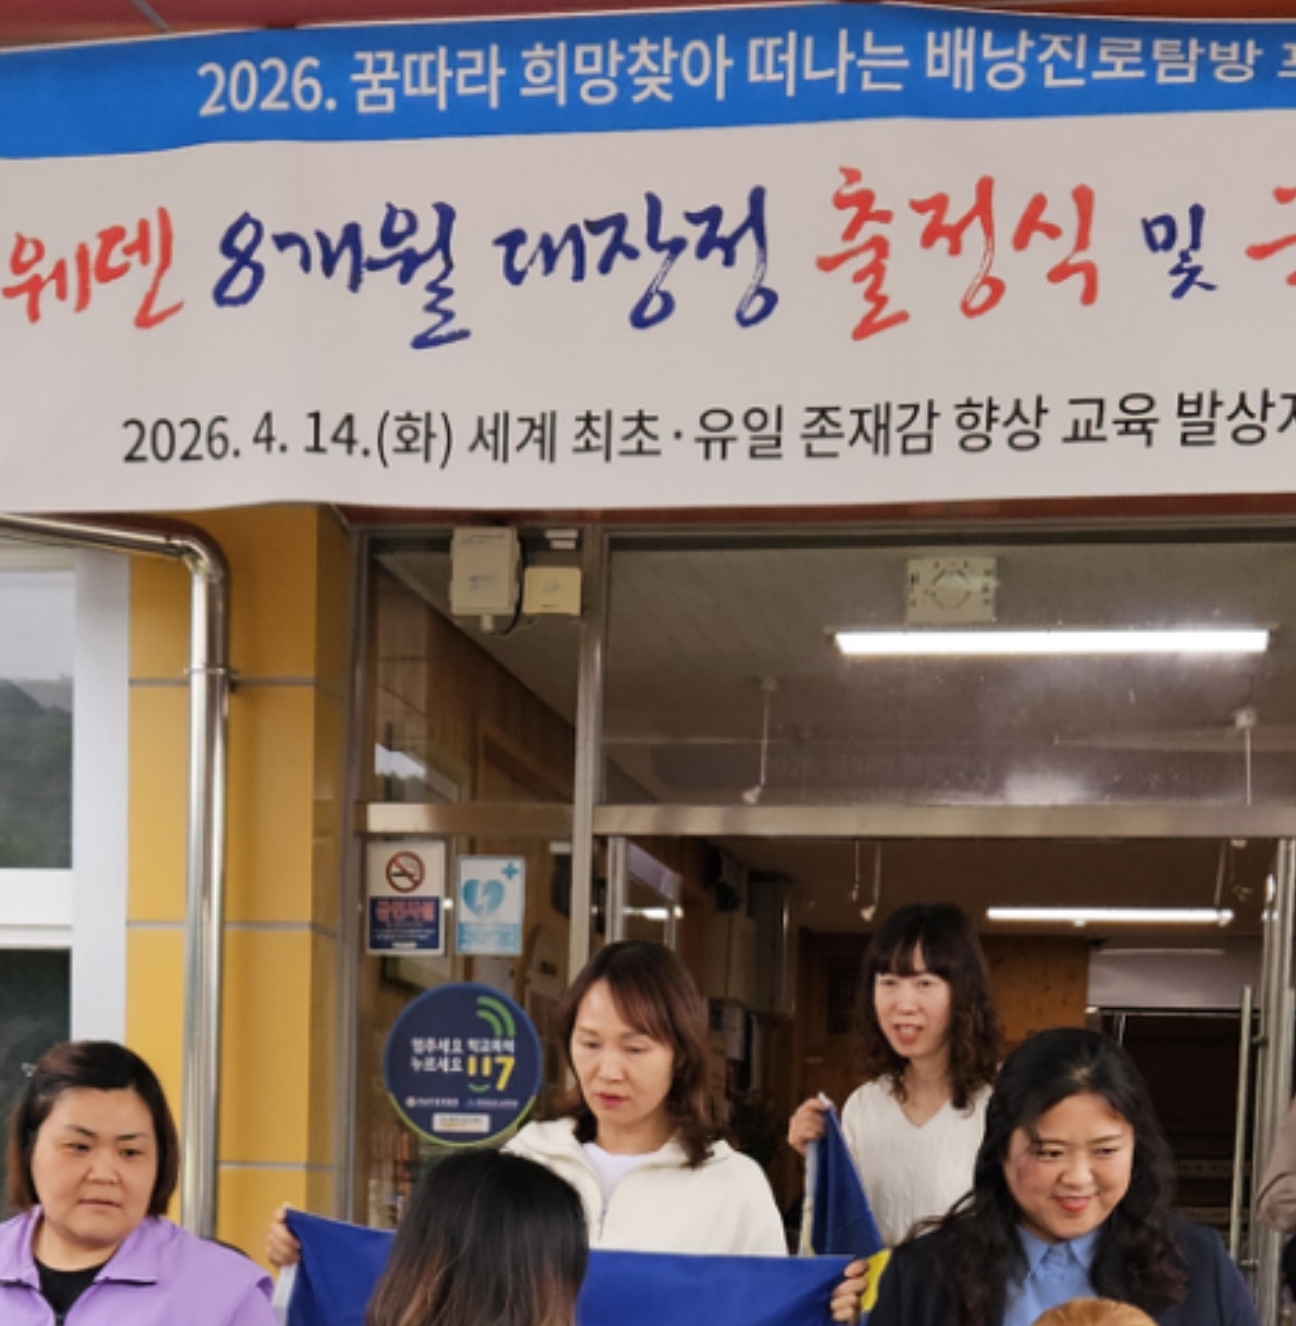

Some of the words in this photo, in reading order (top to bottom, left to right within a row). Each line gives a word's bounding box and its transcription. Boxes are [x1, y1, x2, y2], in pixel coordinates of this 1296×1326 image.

[198, 57, 336, 116] 2026.
[350, 44, 506, 114] 꿈따라
[520, 34, 733, 106] 희망찾아
[747, 28, 910, 97] 떠나는
[926, 27, 1264, 92] 배낭진로탐방
[213, 202, 471, 350] 8개월
[494, 186, 779, 330] 대장정
[815, 166, 1100, 341] 출정식
[1142, 203, 1217, 299] 및
[121, 414, 241, 463] 2026.
[252, 411, 289, 454] 4.
[304, 409, 453, 469] 14.(화)
[467, 410, 558, 464] 세계
[800, 398, 941, 459] 존재감
[953, 394, 1050, 453] 향상
[1061, 391, 1160, 448] 교육
